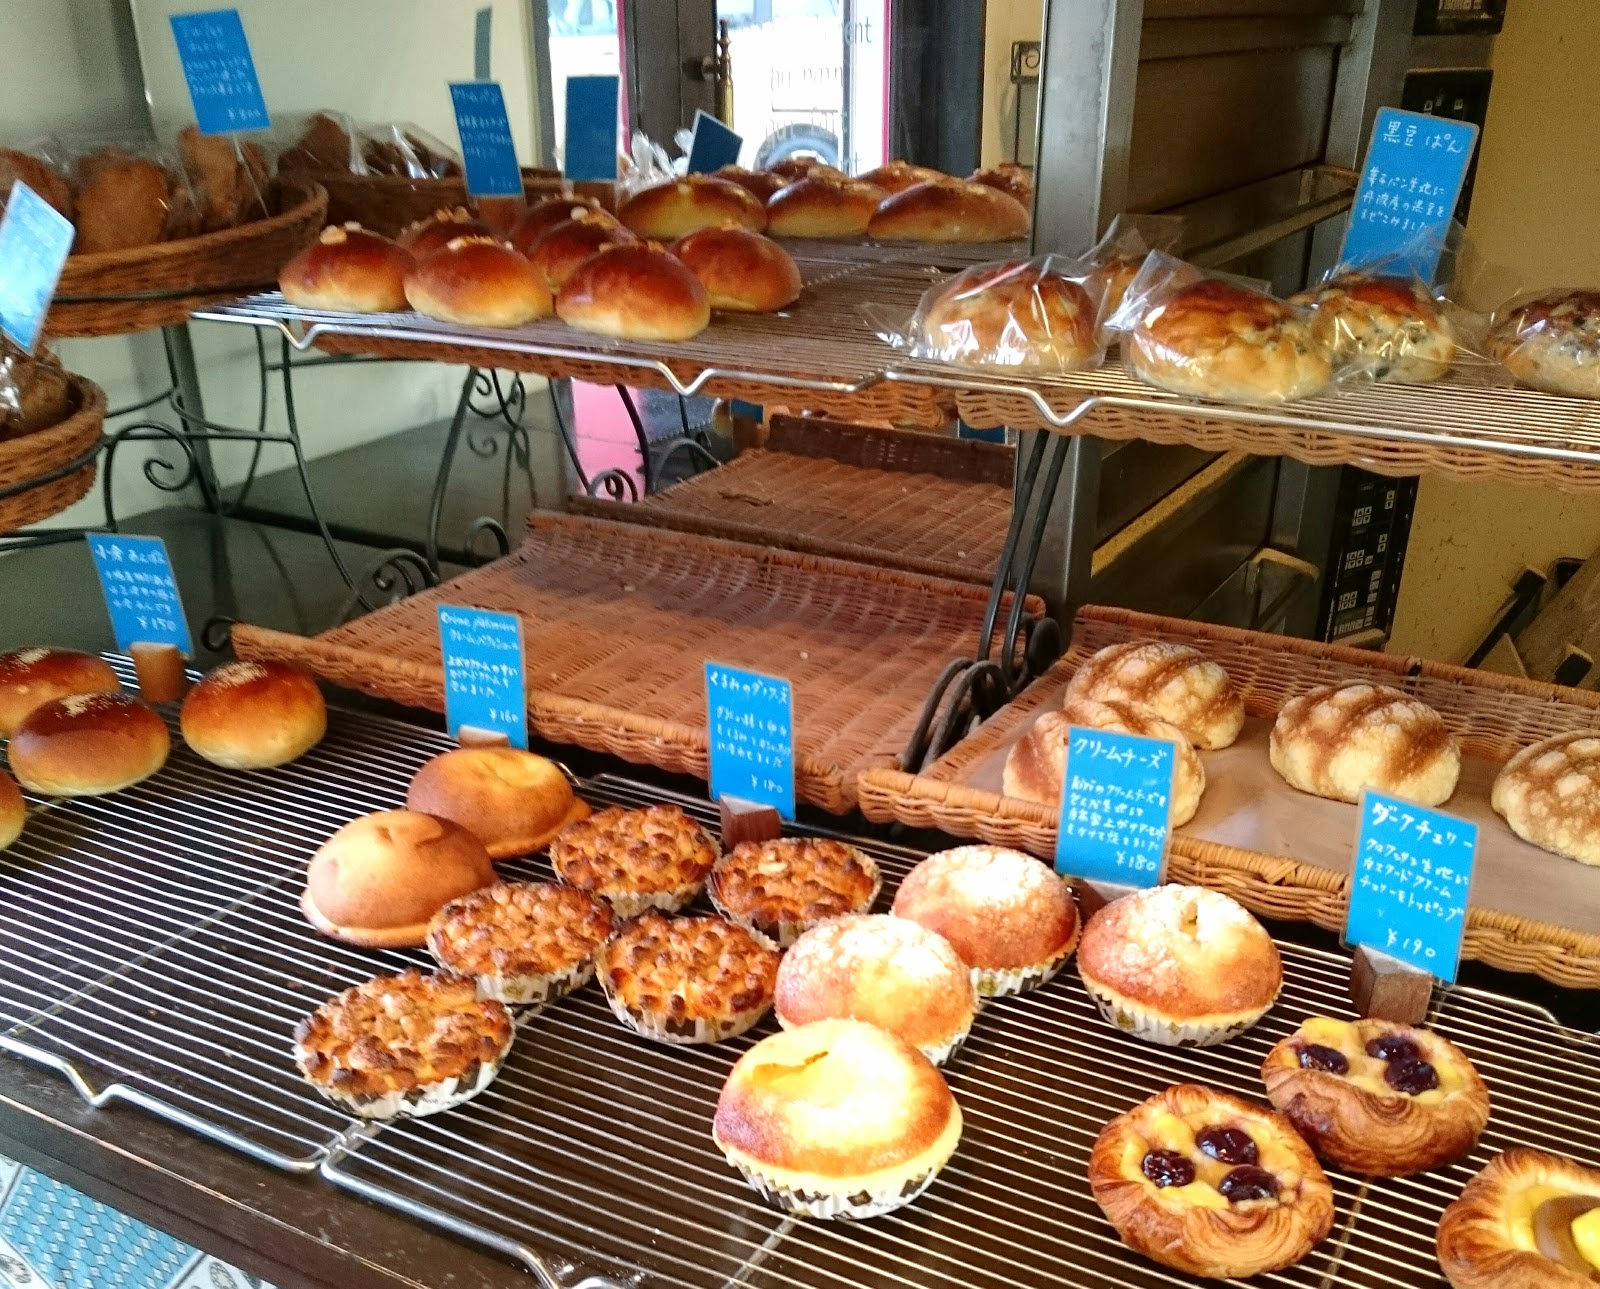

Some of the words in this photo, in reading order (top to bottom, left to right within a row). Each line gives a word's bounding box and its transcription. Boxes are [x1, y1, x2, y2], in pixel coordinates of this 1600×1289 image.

[1384, 121, 1462, 153] 黒豆ぱん
[1073, 738, 1167, 769] クリームチーズ
[1373, 802, 1472, 847] ダークチェリー
[1116, 851, 1156, 871] ¥180
[1387, 928, 1436, 957] ¥190
